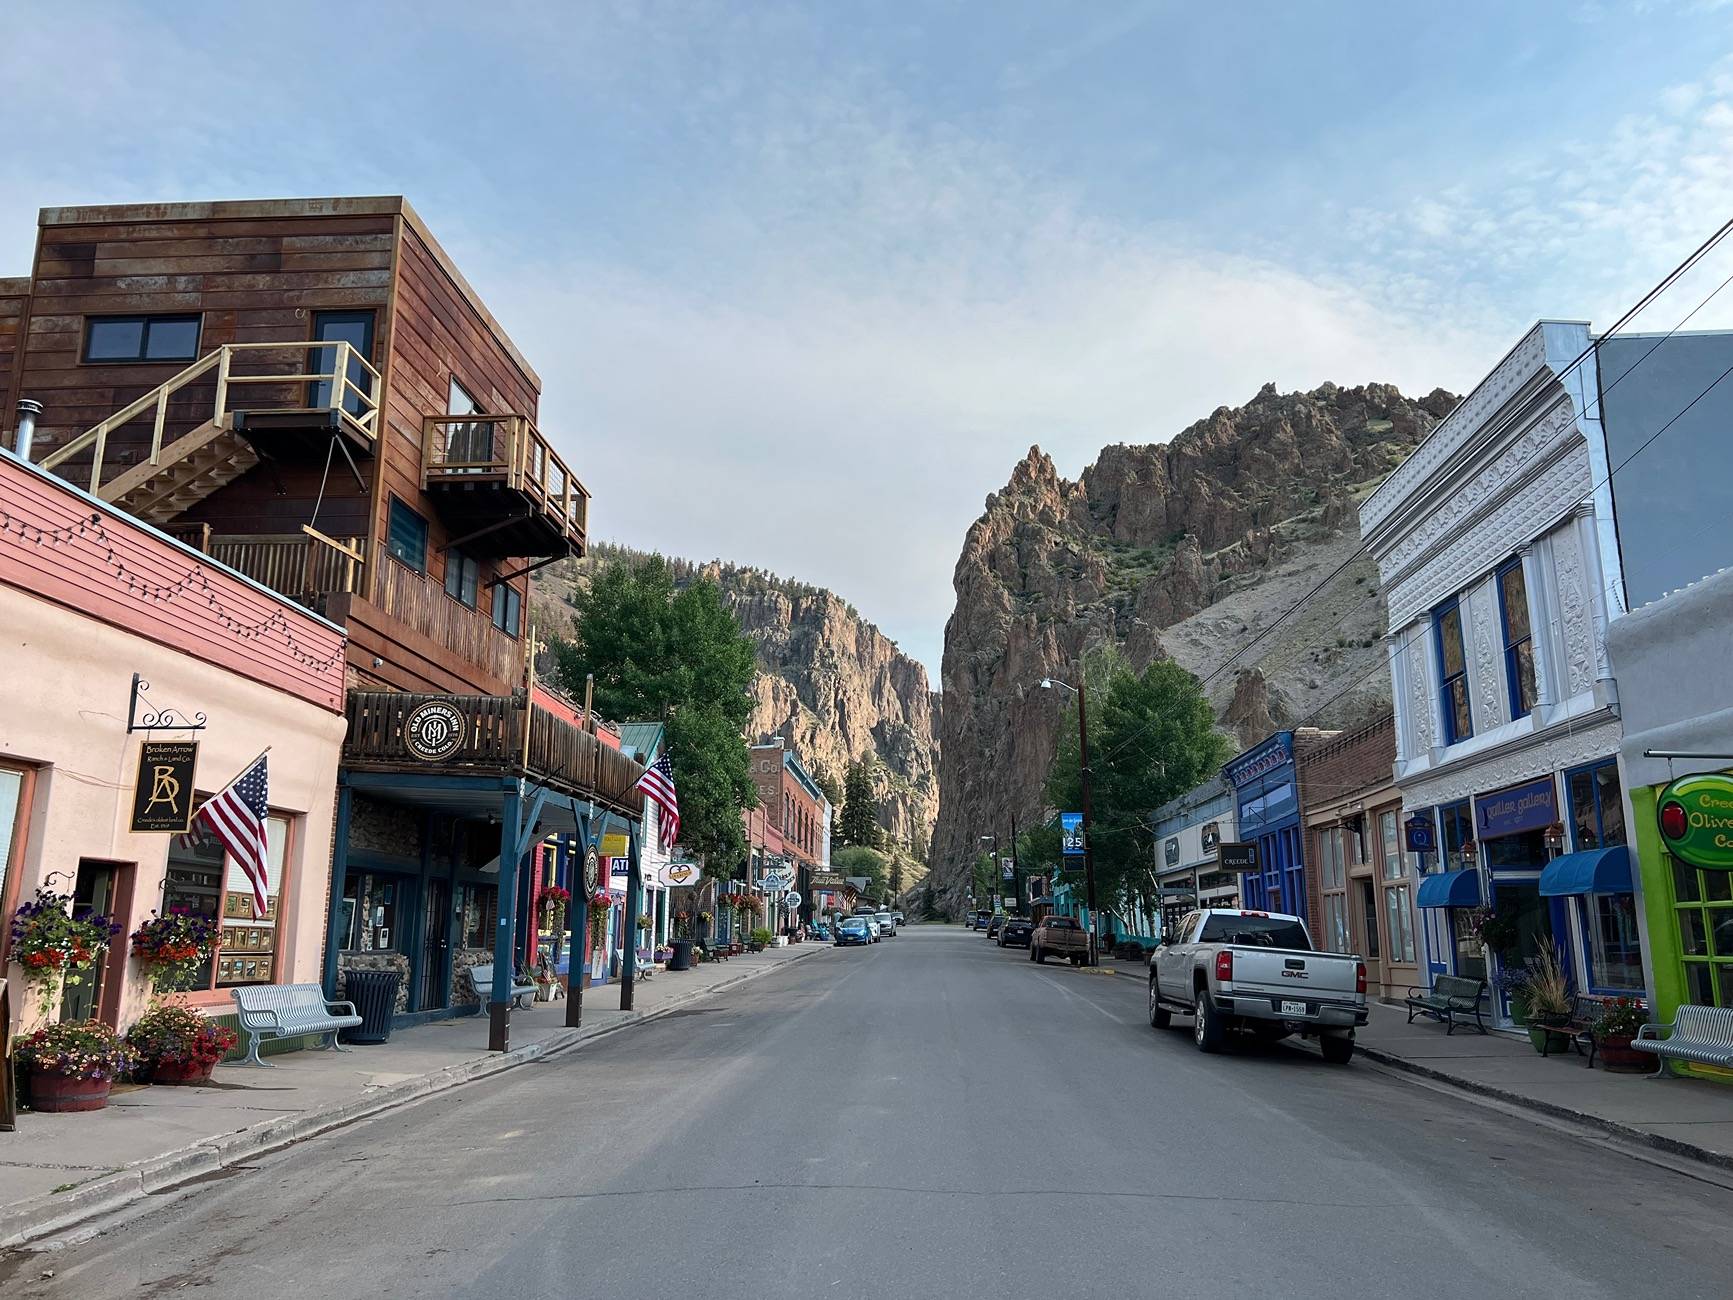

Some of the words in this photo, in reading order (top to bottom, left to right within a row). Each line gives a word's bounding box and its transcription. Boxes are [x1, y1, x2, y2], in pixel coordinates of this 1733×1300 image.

[410, 716, 422, 732] OLD
[420, 707, 453, 718] MINERS
[449, 715, 459, 731] INN
[146, 744, 172, 754] Broken
[414, 741, 437, 754] CREEDE
[168, 755, 181, 763] Land
[1517, 791, 1552, 815] gallery
[1689, 811, 1733, 829] Olive
[1062, 837, 1082, 847] 125
[1281, 970, 1309, 979] GMC
